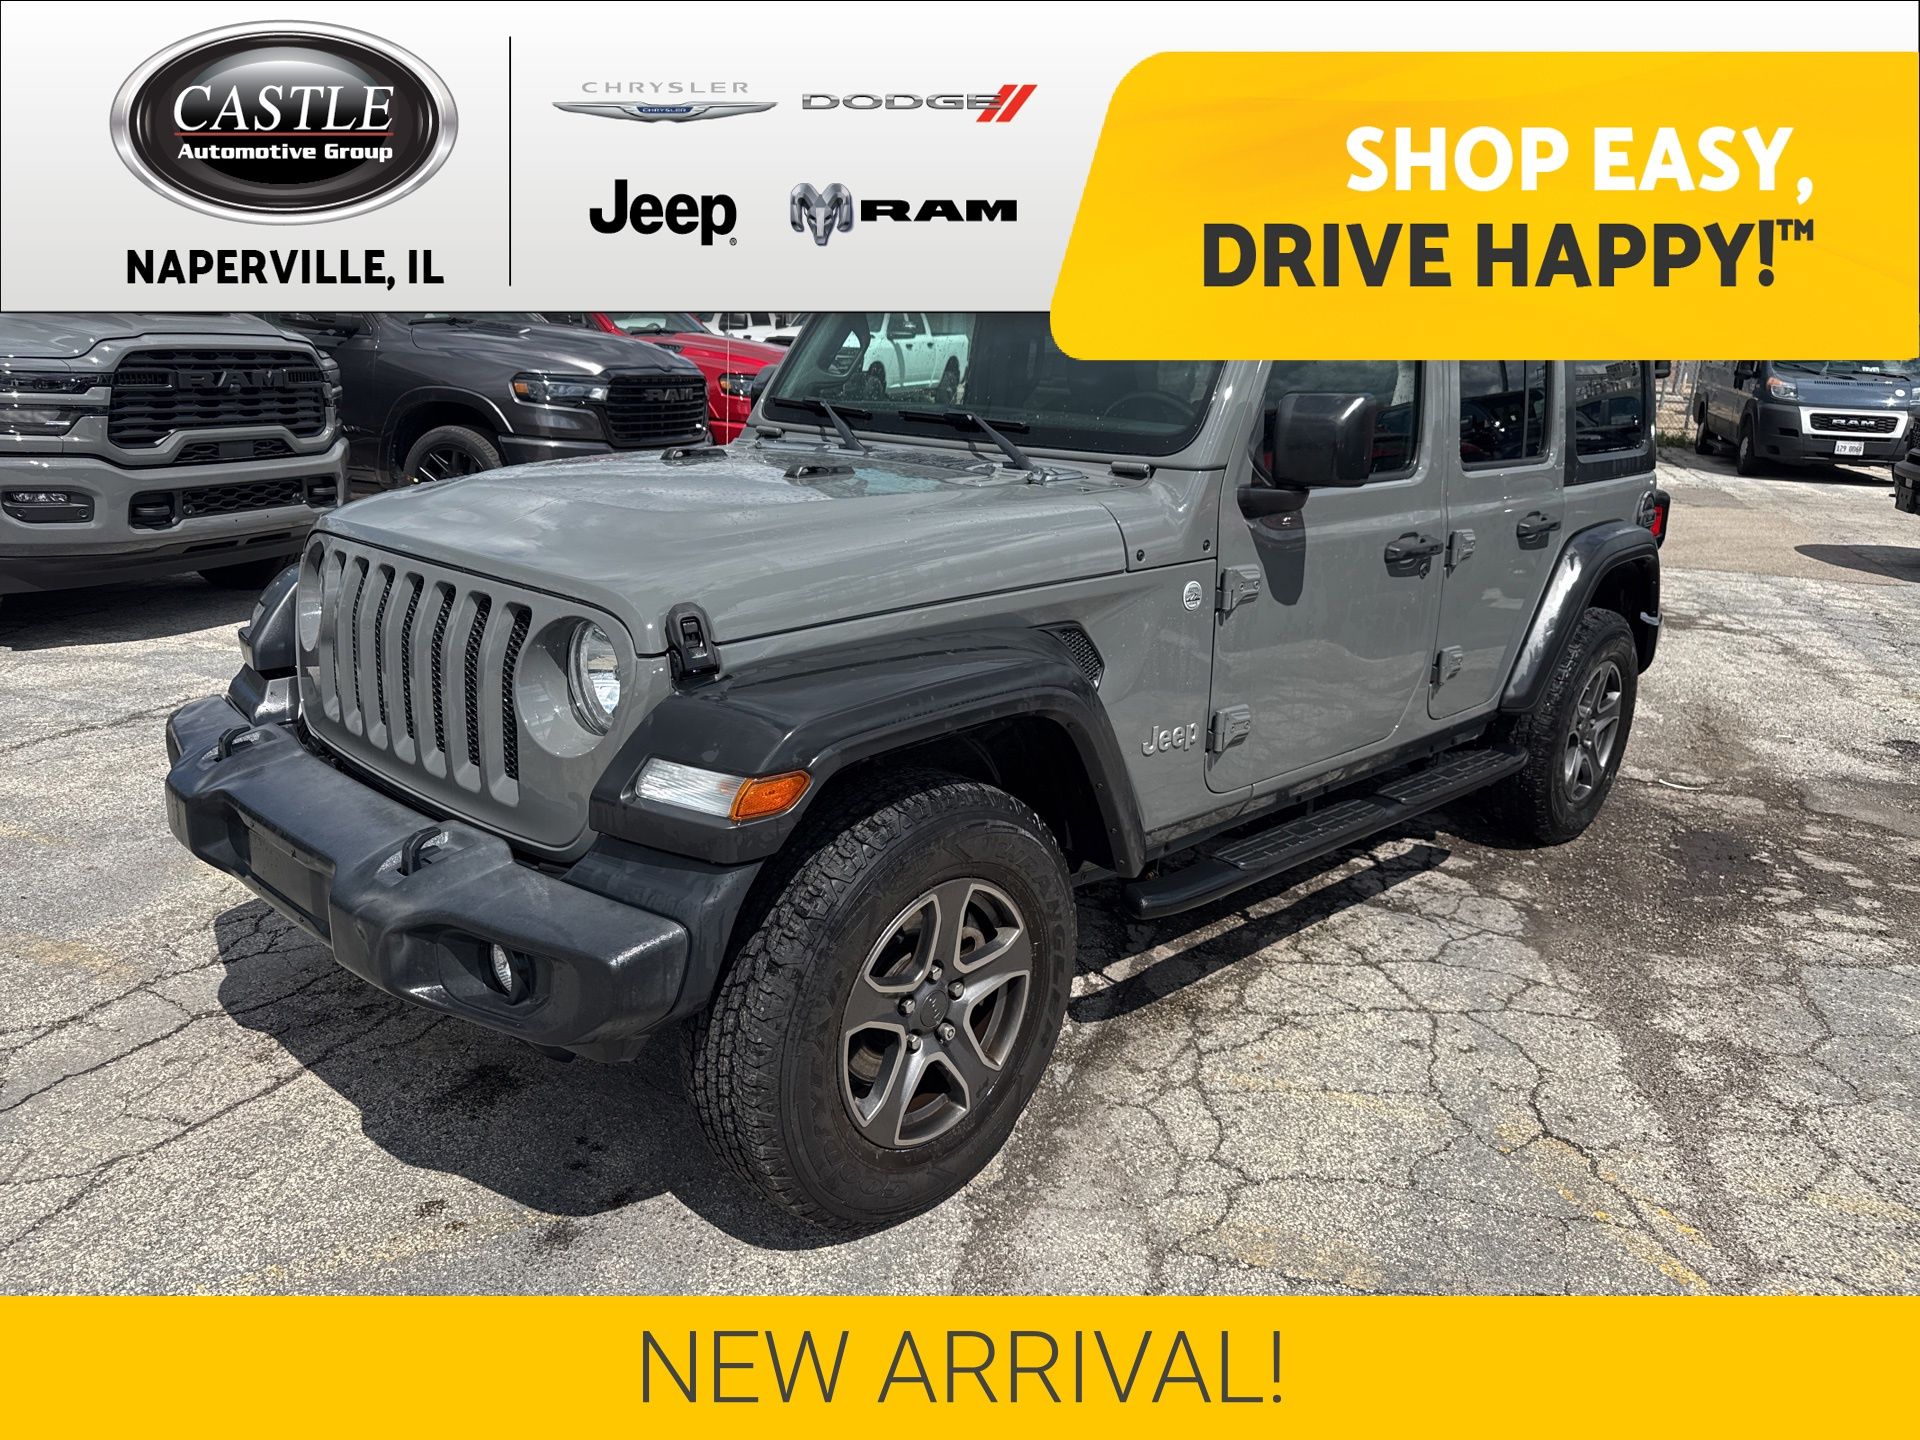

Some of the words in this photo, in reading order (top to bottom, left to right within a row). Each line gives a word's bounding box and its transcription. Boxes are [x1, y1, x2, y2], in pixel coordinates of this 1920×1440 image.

[179, 369, 286, 388] RAM
[645, 388, 694, 401] RAM
[1142, 722, 1200, 757] Jeep
